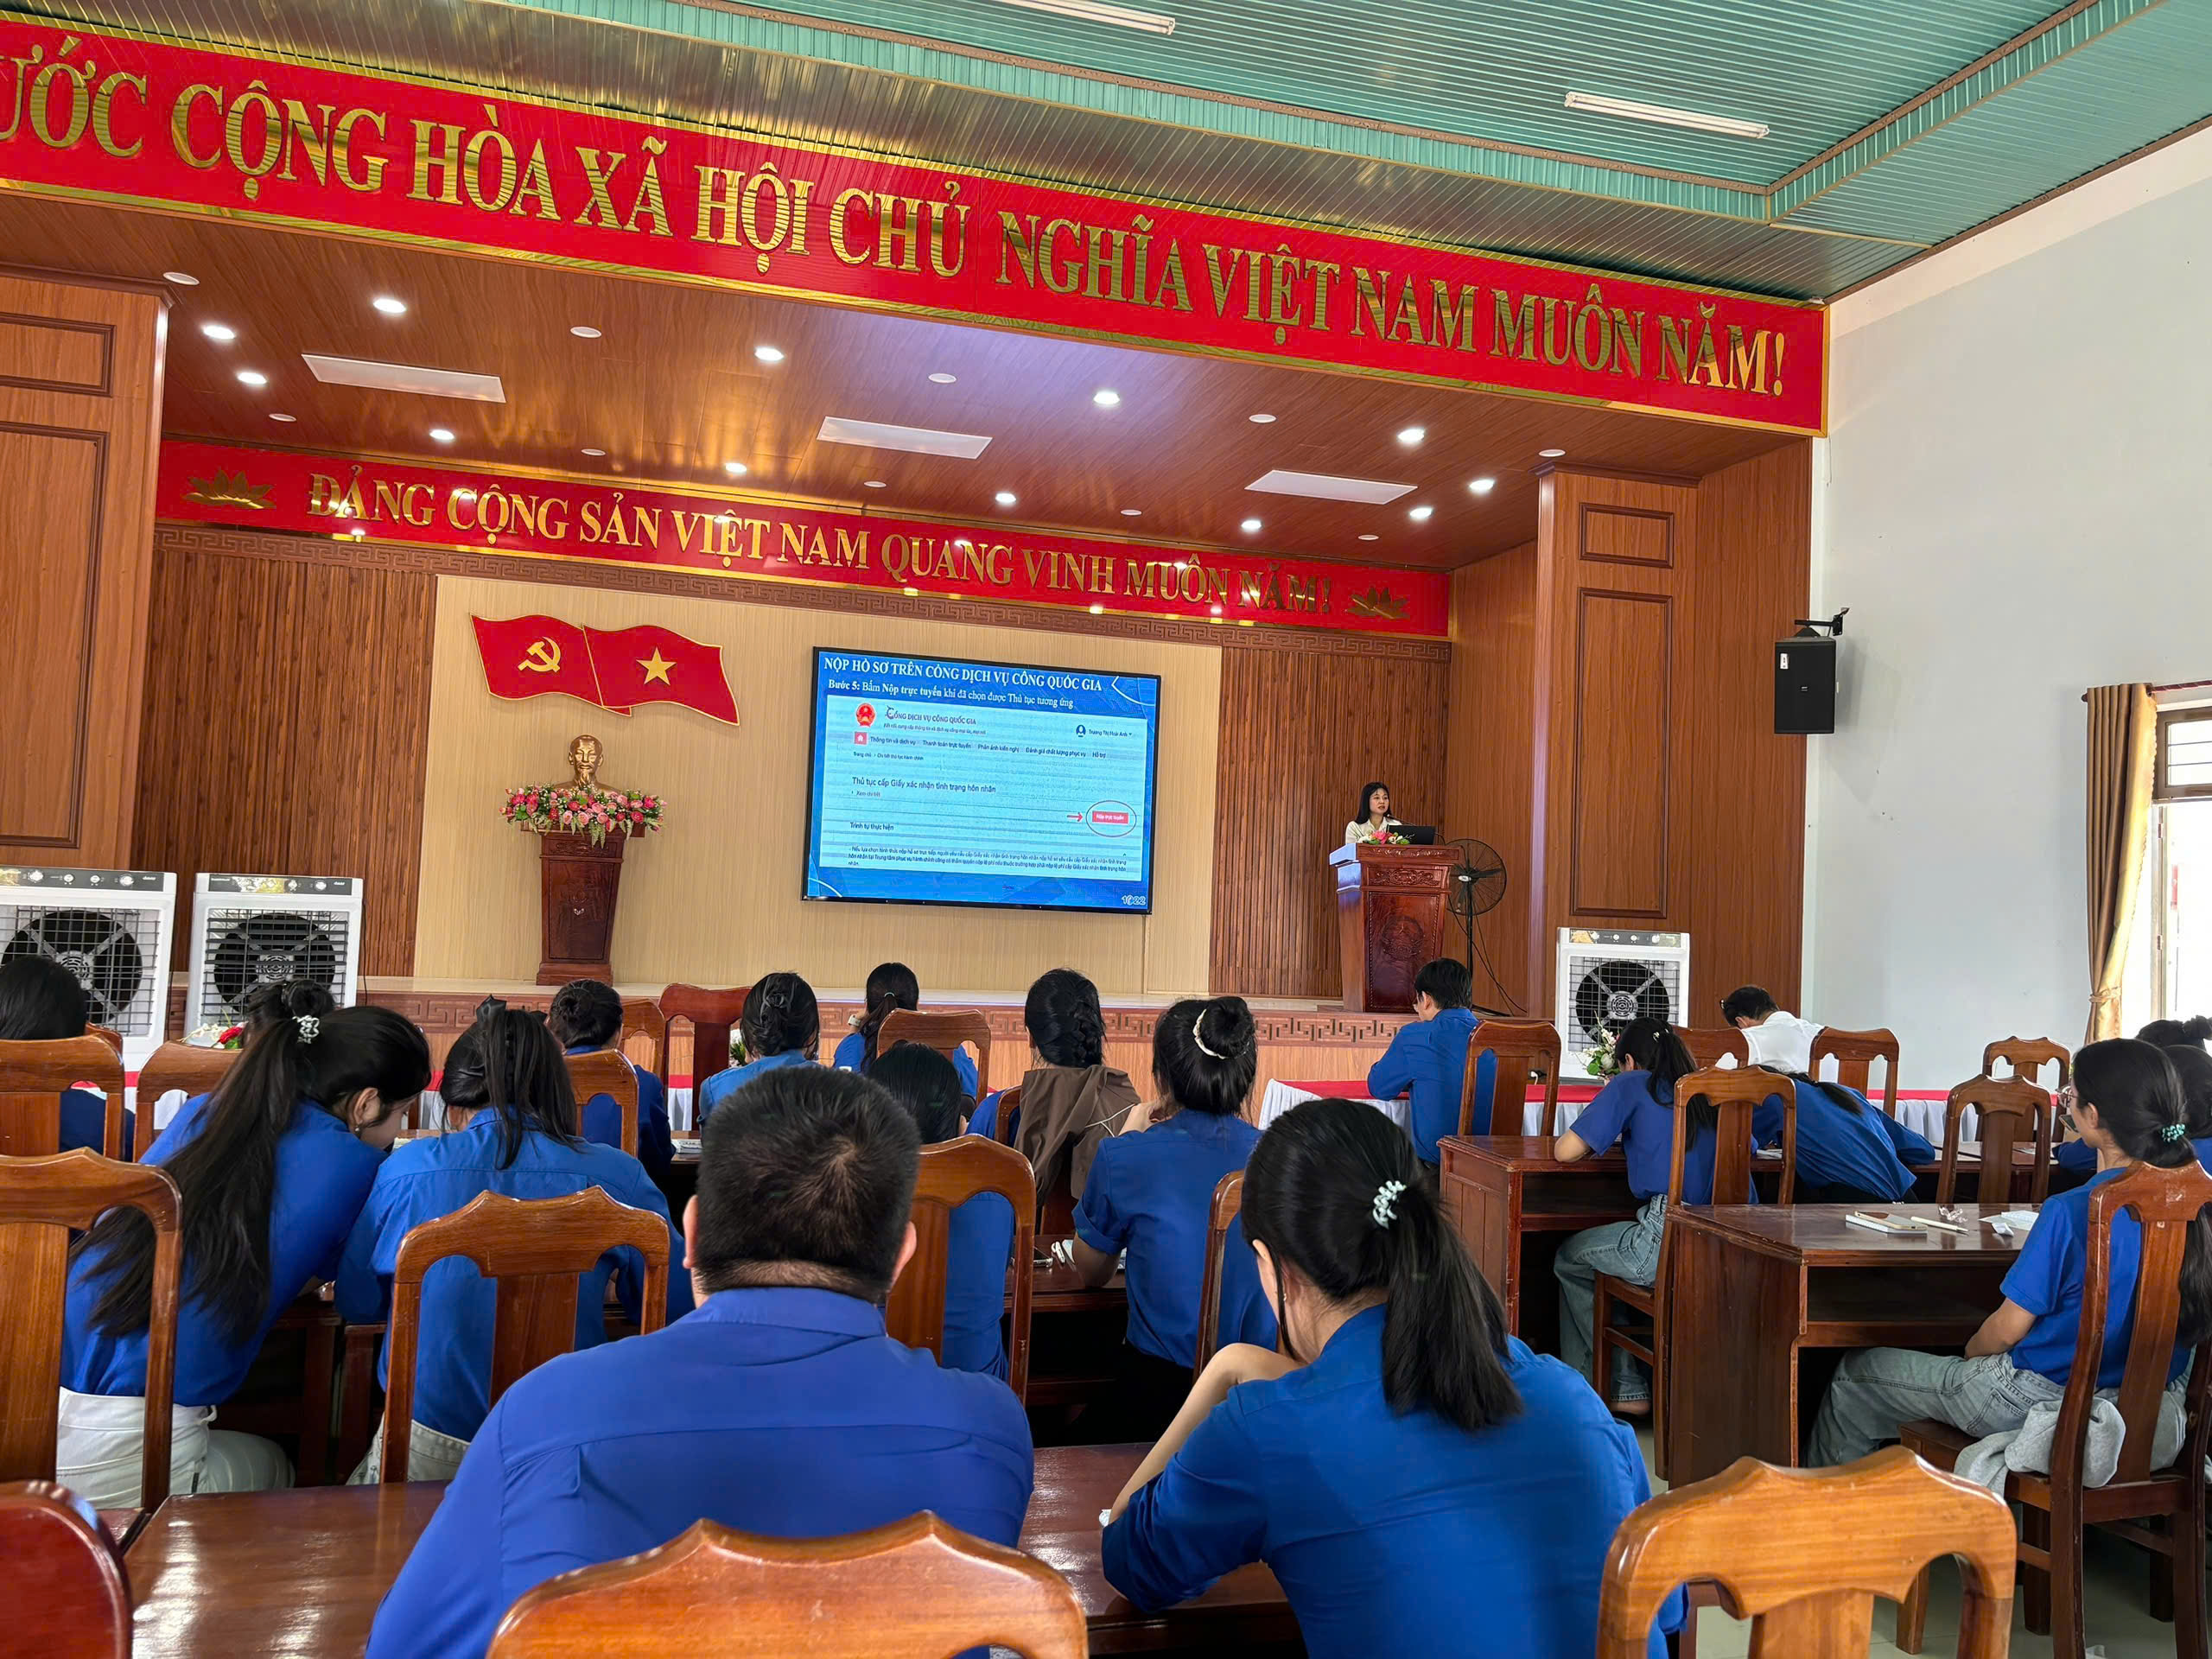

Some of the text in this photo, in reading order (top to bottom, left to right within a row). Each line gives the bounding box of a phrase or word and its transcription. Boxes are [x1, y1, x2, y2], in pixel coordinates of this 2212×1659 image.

[172, 81, 388, 200] CỘNG
[406, 104, 561, 221] HÒA
[574, 136, 674, 236] XÃ
[690, 162, 814, 274] HỘI
[829, 181, 970, 278] CHỦ
[995, 214, 1195, 314] NGHĨA
[1202, 243, 1340, 346] VIỆT
[1351, 269, 1478, 354] NAM
[1490, 283, 1642, 377] MUÔN
[1656, 301, 1787, 397] NĂM!
[307, 465, 1332, 613] ĐẢNG CỘNG SẢN VIỆT NAM QUANG VINH MUÔN NĂM!
[823, 656, 849, 674] NỘP
[873, 660, 889, 675] SƠ
[891, 661, 922, 677] TRÊN
[962, 669, 990, 685] DỊCH
[994, 671, 1010, 687] VỤ
[1012, 671, 1045, 687] CÔNG
[1082, 679, 1103, 692] GIA
[829, 679, 1074, 709] Bước 5: Bấm Nộp trực tuyến khi đã chọn được Thủ tục tương ứng
[866, 779, 876, 787] tục
[877, 778, 889, 787] cấp
[890, 779, 905, 788] Giấy
[918, 781, 934, 791] nhận
[950, 784, 966, 792] trạng
